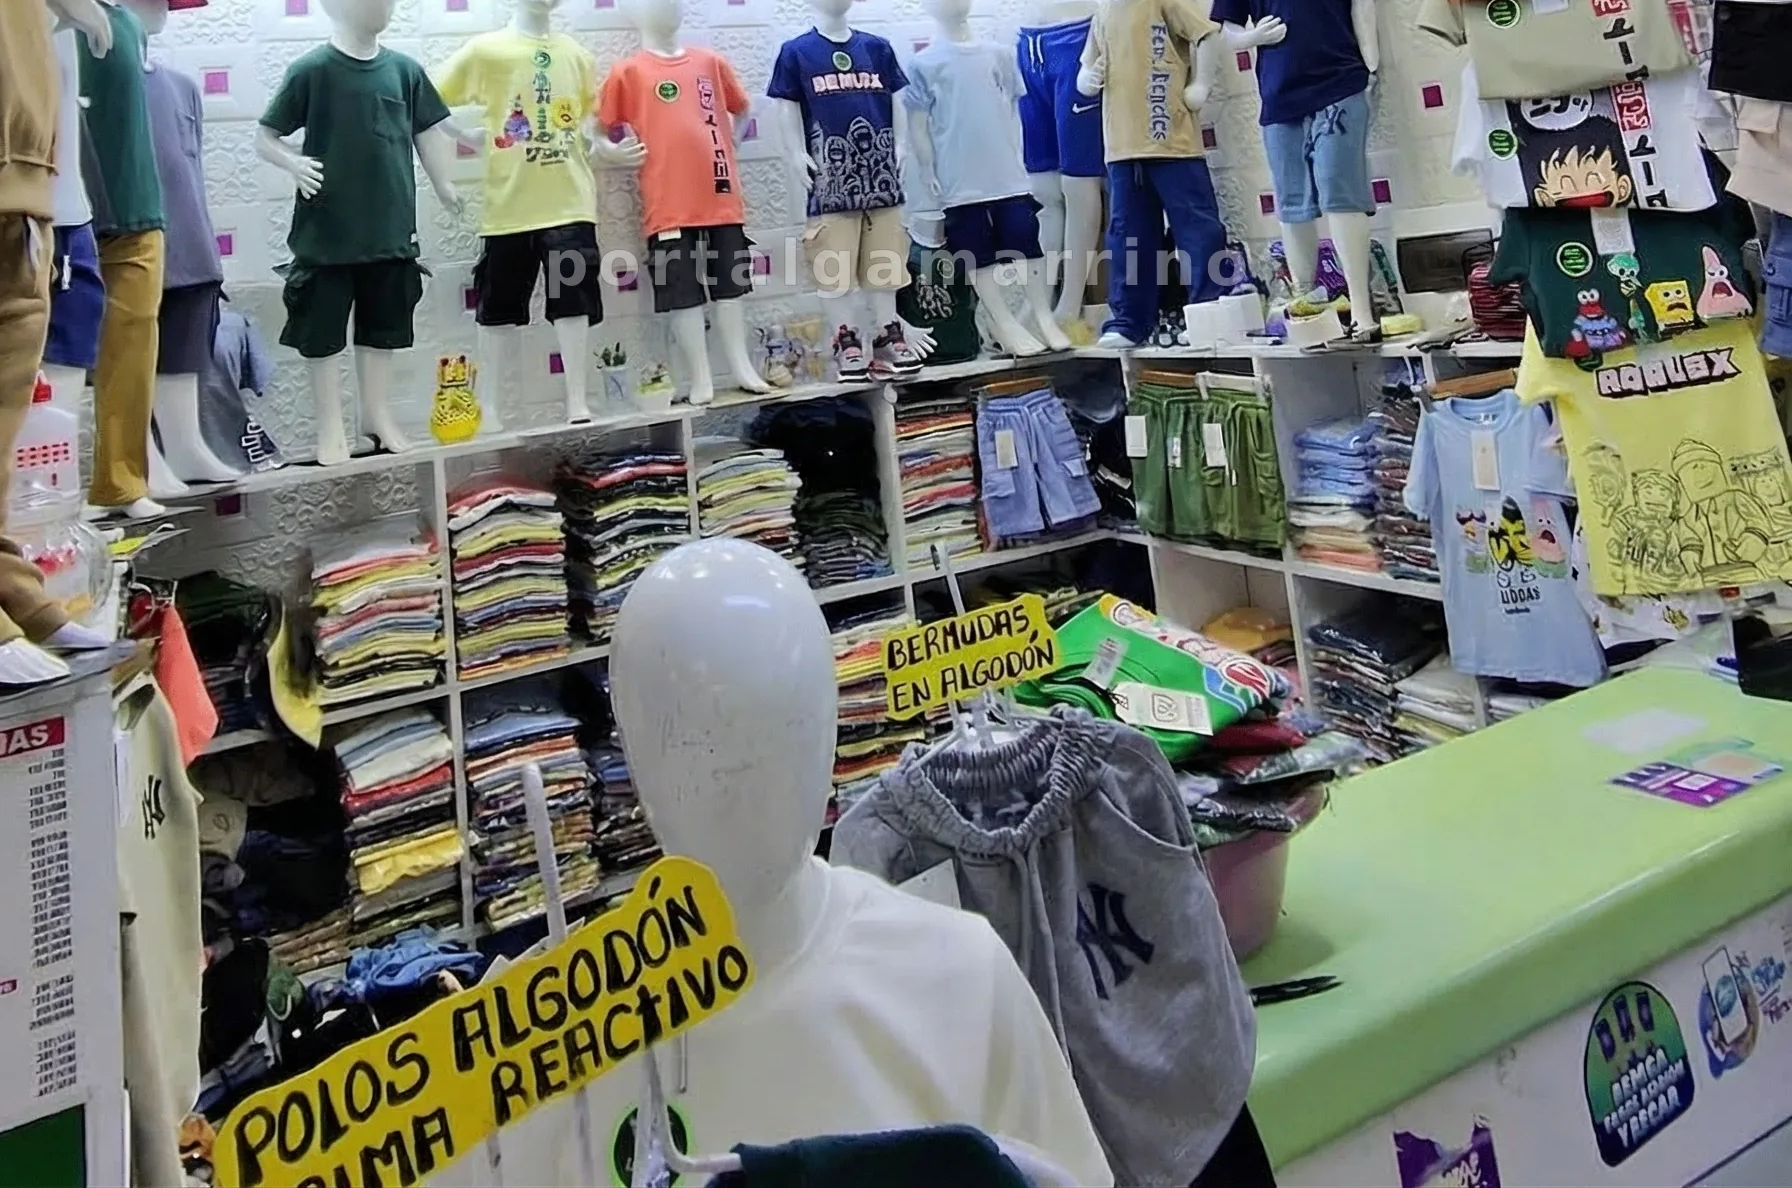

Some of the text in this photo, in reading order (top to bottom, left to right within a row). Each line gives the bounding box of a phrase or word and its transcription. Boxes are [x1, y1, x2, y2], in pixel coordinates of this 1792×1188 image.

[887, 605, 1031, 670] BERMUDAS
[892, 677, 931, 712] EN
[941, 631, 1055, 701] ALGODÓN
[236, 1032, 431, 1188] POLOS
[452, 876, 708, 1073] ALGODÓN
